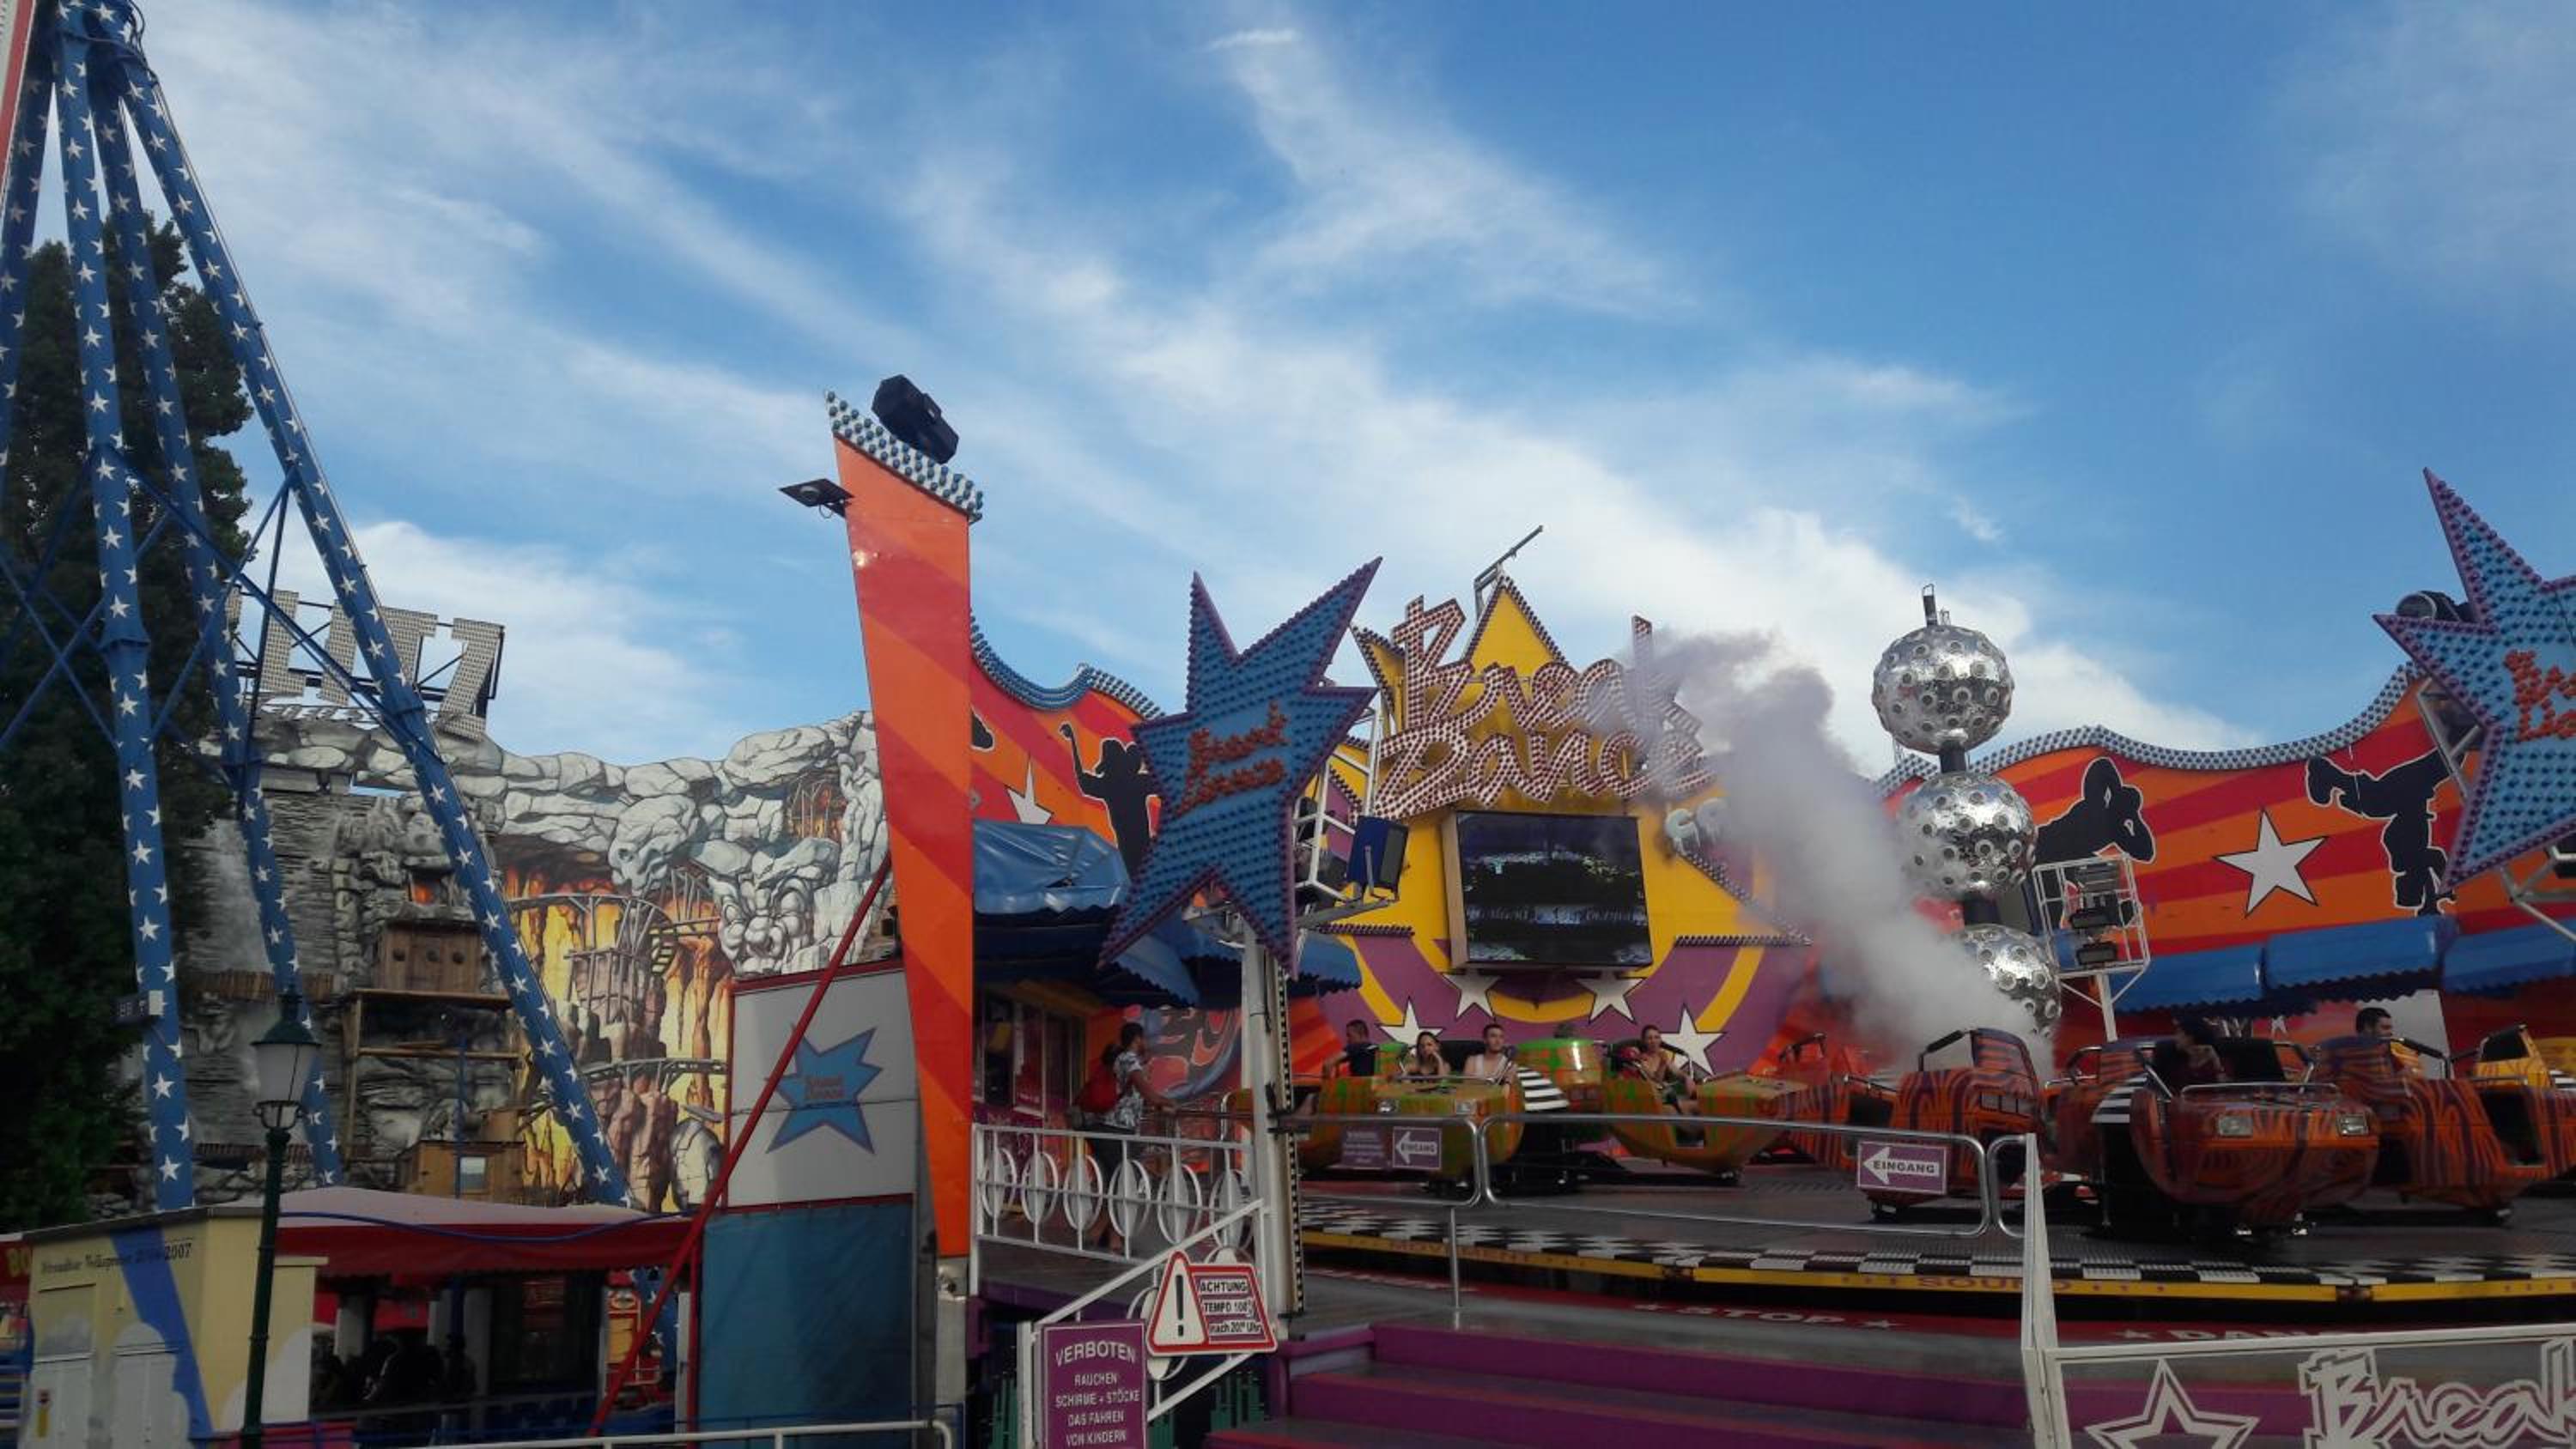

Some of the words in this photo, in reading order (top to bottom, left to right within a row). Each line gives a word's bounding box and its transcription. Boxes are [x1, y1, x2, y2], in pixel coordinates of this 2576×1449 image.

[225, 584, 504, 742] LITZ
[1393, 595, 1704, 737] Break
[1374, 718, 1717, 822] Dance
[1873, 1159, 1935, 1174] EINGANG
[1200, 1281, 1248, 1293] ACHTUNG
[1204, 1301, 1231, 1313] TEMPO
[1675, 1305, 1846, 1324] STOP
[1055, 1340, 1136, 1367] VERBOTEN
[1074, 1372, 1119, 1387] RAUCHEN
[1067, 1413, 1087, 1427] DAS
[1088, 1410, 1125, 1425] FAHREN
[1066, 1433, 1085, 1447] VON
[1086, 1428, 1127, 1445] KINDERN
